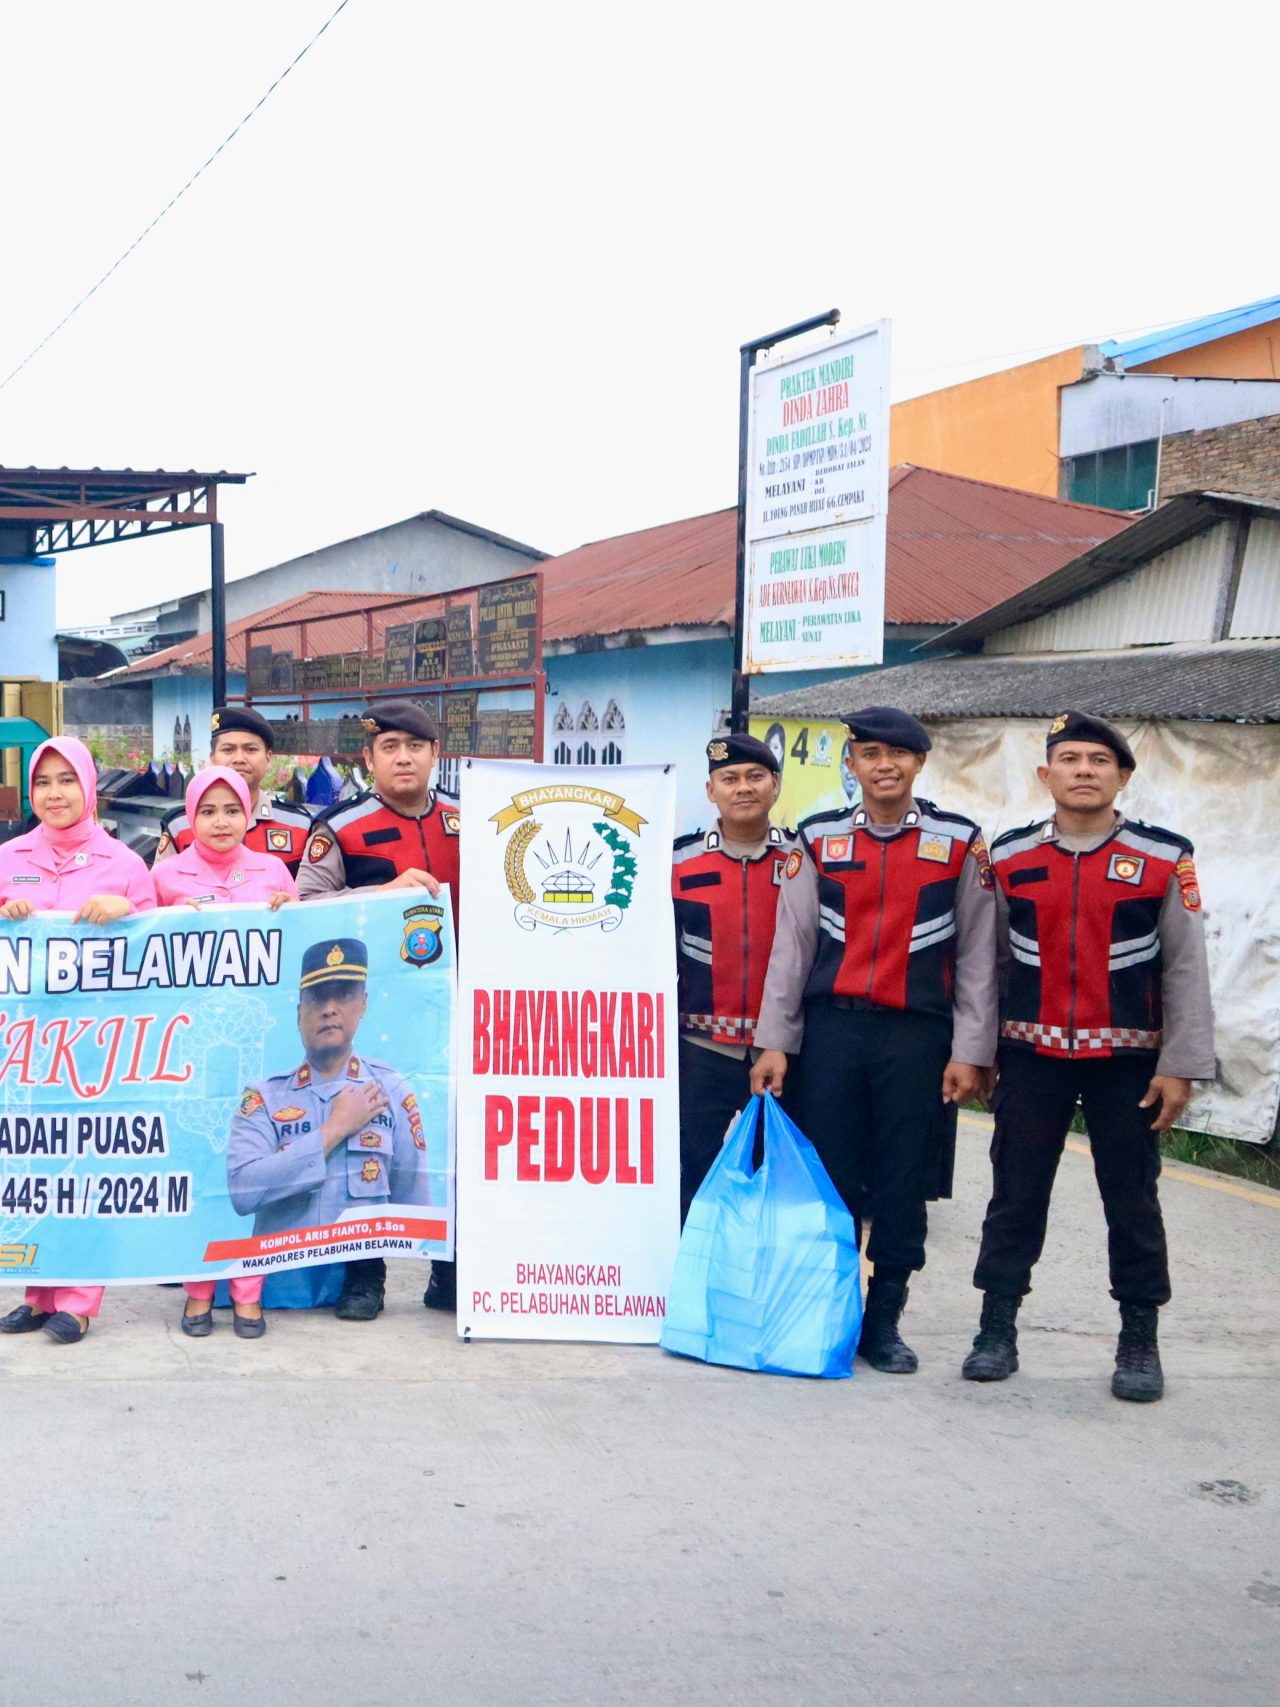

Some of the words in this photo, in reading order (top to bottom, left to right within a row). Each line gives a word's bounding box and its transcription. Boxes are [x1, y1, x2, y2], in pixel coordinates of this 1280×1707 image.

[780, 367, 816, 400] PRAKTEK
[819, 355, 853, 387] MANDIRI
[783, 394, 812, 427] DINDA
[816, 382, 848, 417] ZAHRA
[767, 433, 789, 456] DINDA
[847, 459, 865, 469] JALAN
[765, 479, 805, 499] MELAYANI
[819, 540, 846, 567] MODERN
[760, 619, 795, 643] MELAYANI
[802, 612, 842, 626] PERAWATAN
[845, 611, 861, 624] LUKA
[791, 727, 809, 765] 4
[519, 788, 617, 809] BHAYANGKARI
[527, 908, 569, 925] KEMALA
[571, 908, 612, 925] HIKMAH
[45, 929, 282, 994] BELAWAN
[472, 988, 665, 1079] BHAYANGKARI
[77, 1116, 165, 1154] PUASA
[484, 1094, 654, 1184] PEDULI
[56, 1177, 74, 1214] H
[98, 1176, 159, 1214] 2024
[167, 1176, 188, 1214] M
[260, 1235, 302, 1250] KOMPOL
[305, 1231, 330, 1241] ARIS
[332, 1224, 373, 1238] FIANTO,
[375, 1221, 406, 1232] S.Sos
[242, 1250, 305, 1269] WAKAPOLRES
[307, 1243, 362, 1258] PELABUHAN
[364, 1239, 413, 1250] BELAWAN
[516, 1263, 621, 1287] BHAYANGKARI
[473, 1291, 496, 1313] PC.
[501, 1292, 590, 1316] PELABUHAN
[594, 1294, 666, 1317] BELAWAN
